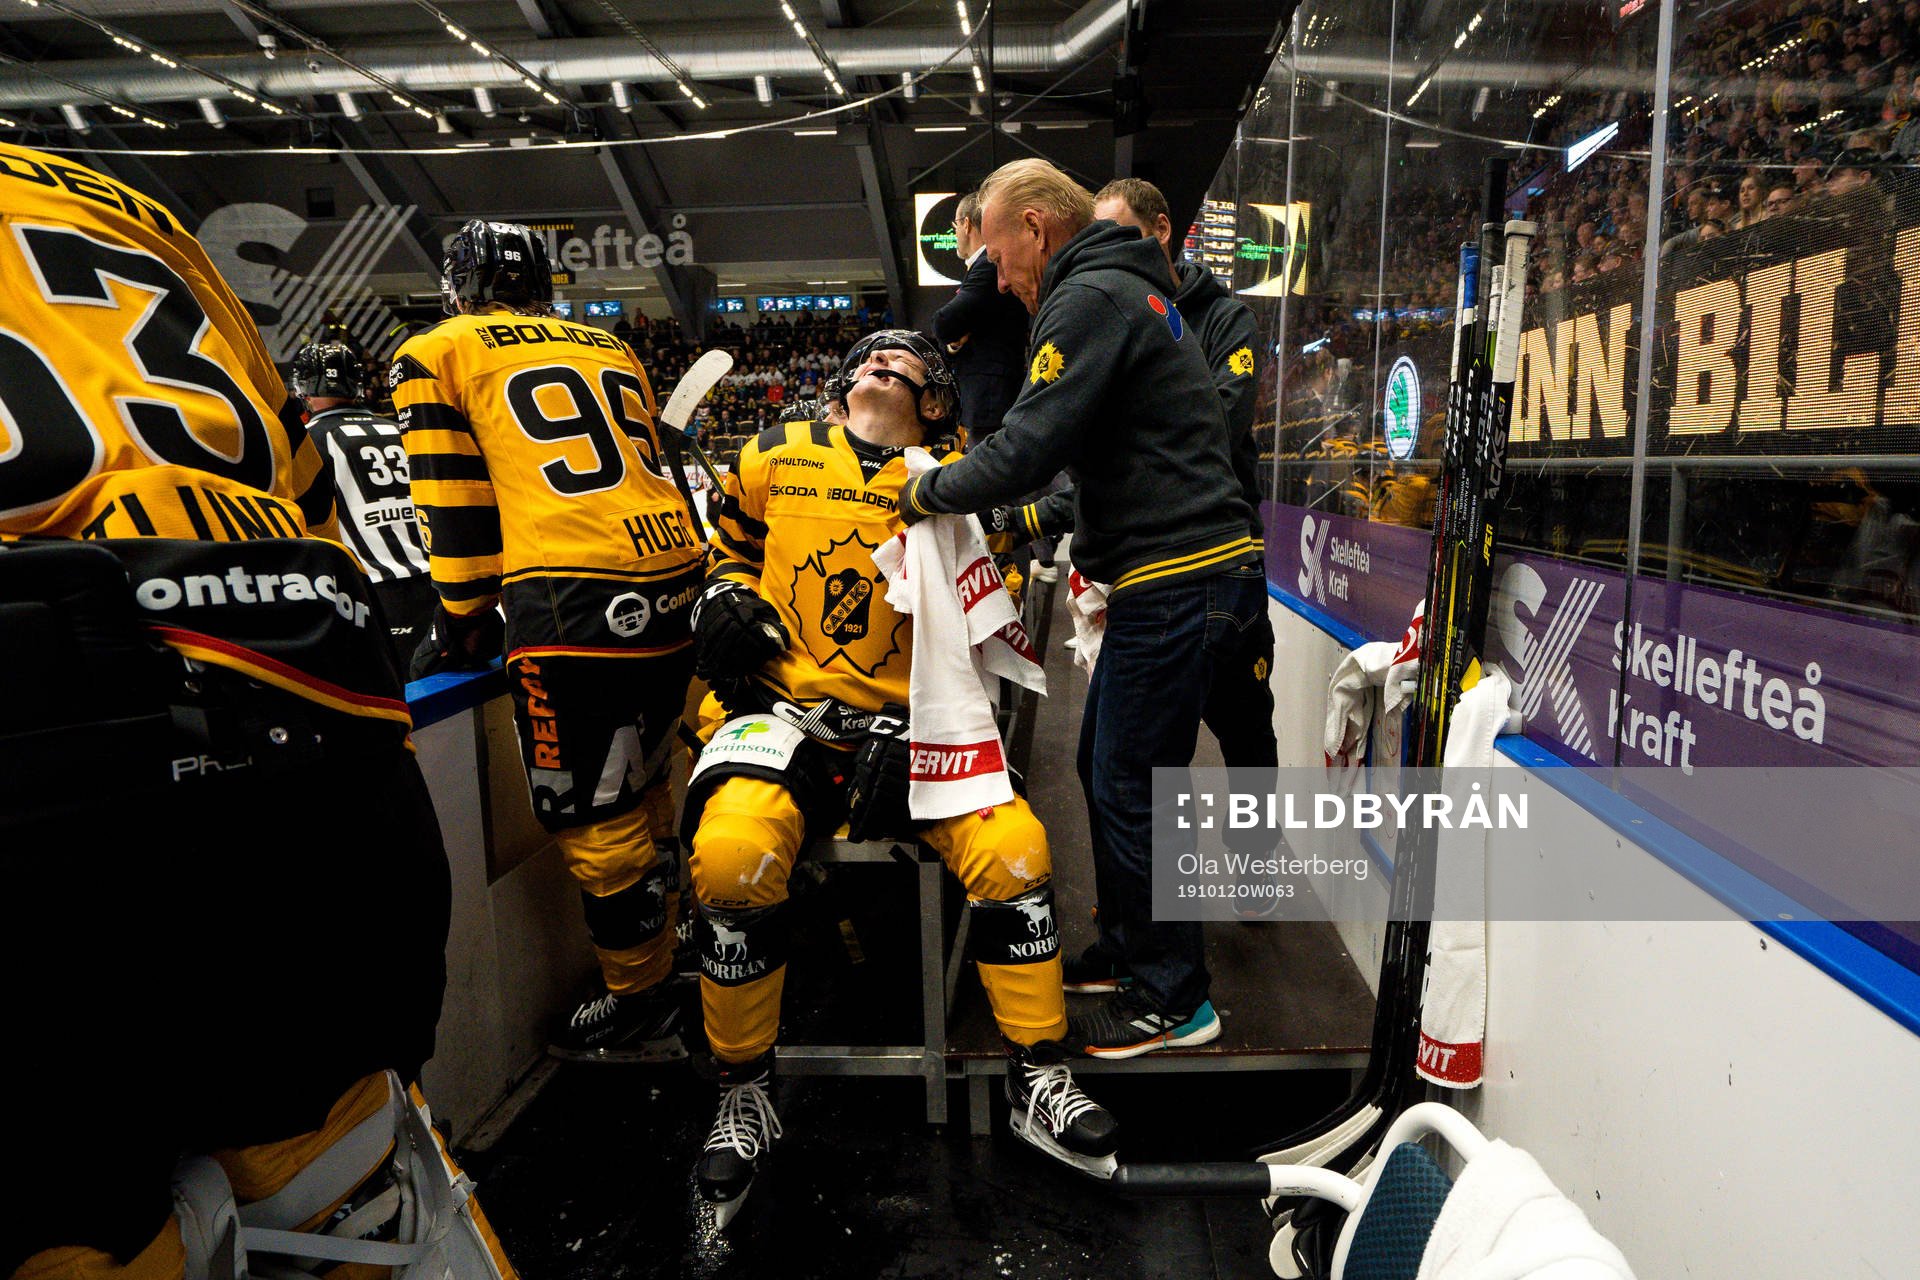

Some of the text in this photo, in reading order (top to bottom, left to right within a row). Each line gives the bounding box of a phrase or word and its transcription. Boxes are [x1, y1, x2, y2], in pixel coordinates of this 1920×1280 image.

[504, 250, 521, 262] 96
[490, 323, 630, 353] BOLIDEN
[326, 368, 338, 378] 33
[359, 445, 410, 487] 33
[779, 457, 825, 470] HULTDINS
[861, 459, 883, 470] SHL
[769, 483, 818, 498] ŠKODA
[831, 487, 899, 514] BOLIDEN
[1328, 569, 1349, 602] Kraft
[843, 623, 863, 633] 1921
[1612, 619, 1827, 745] Skellefteå
[1607, 688, 1697, 777] Kraft
[701, 953, 767, 980] NORRAN
